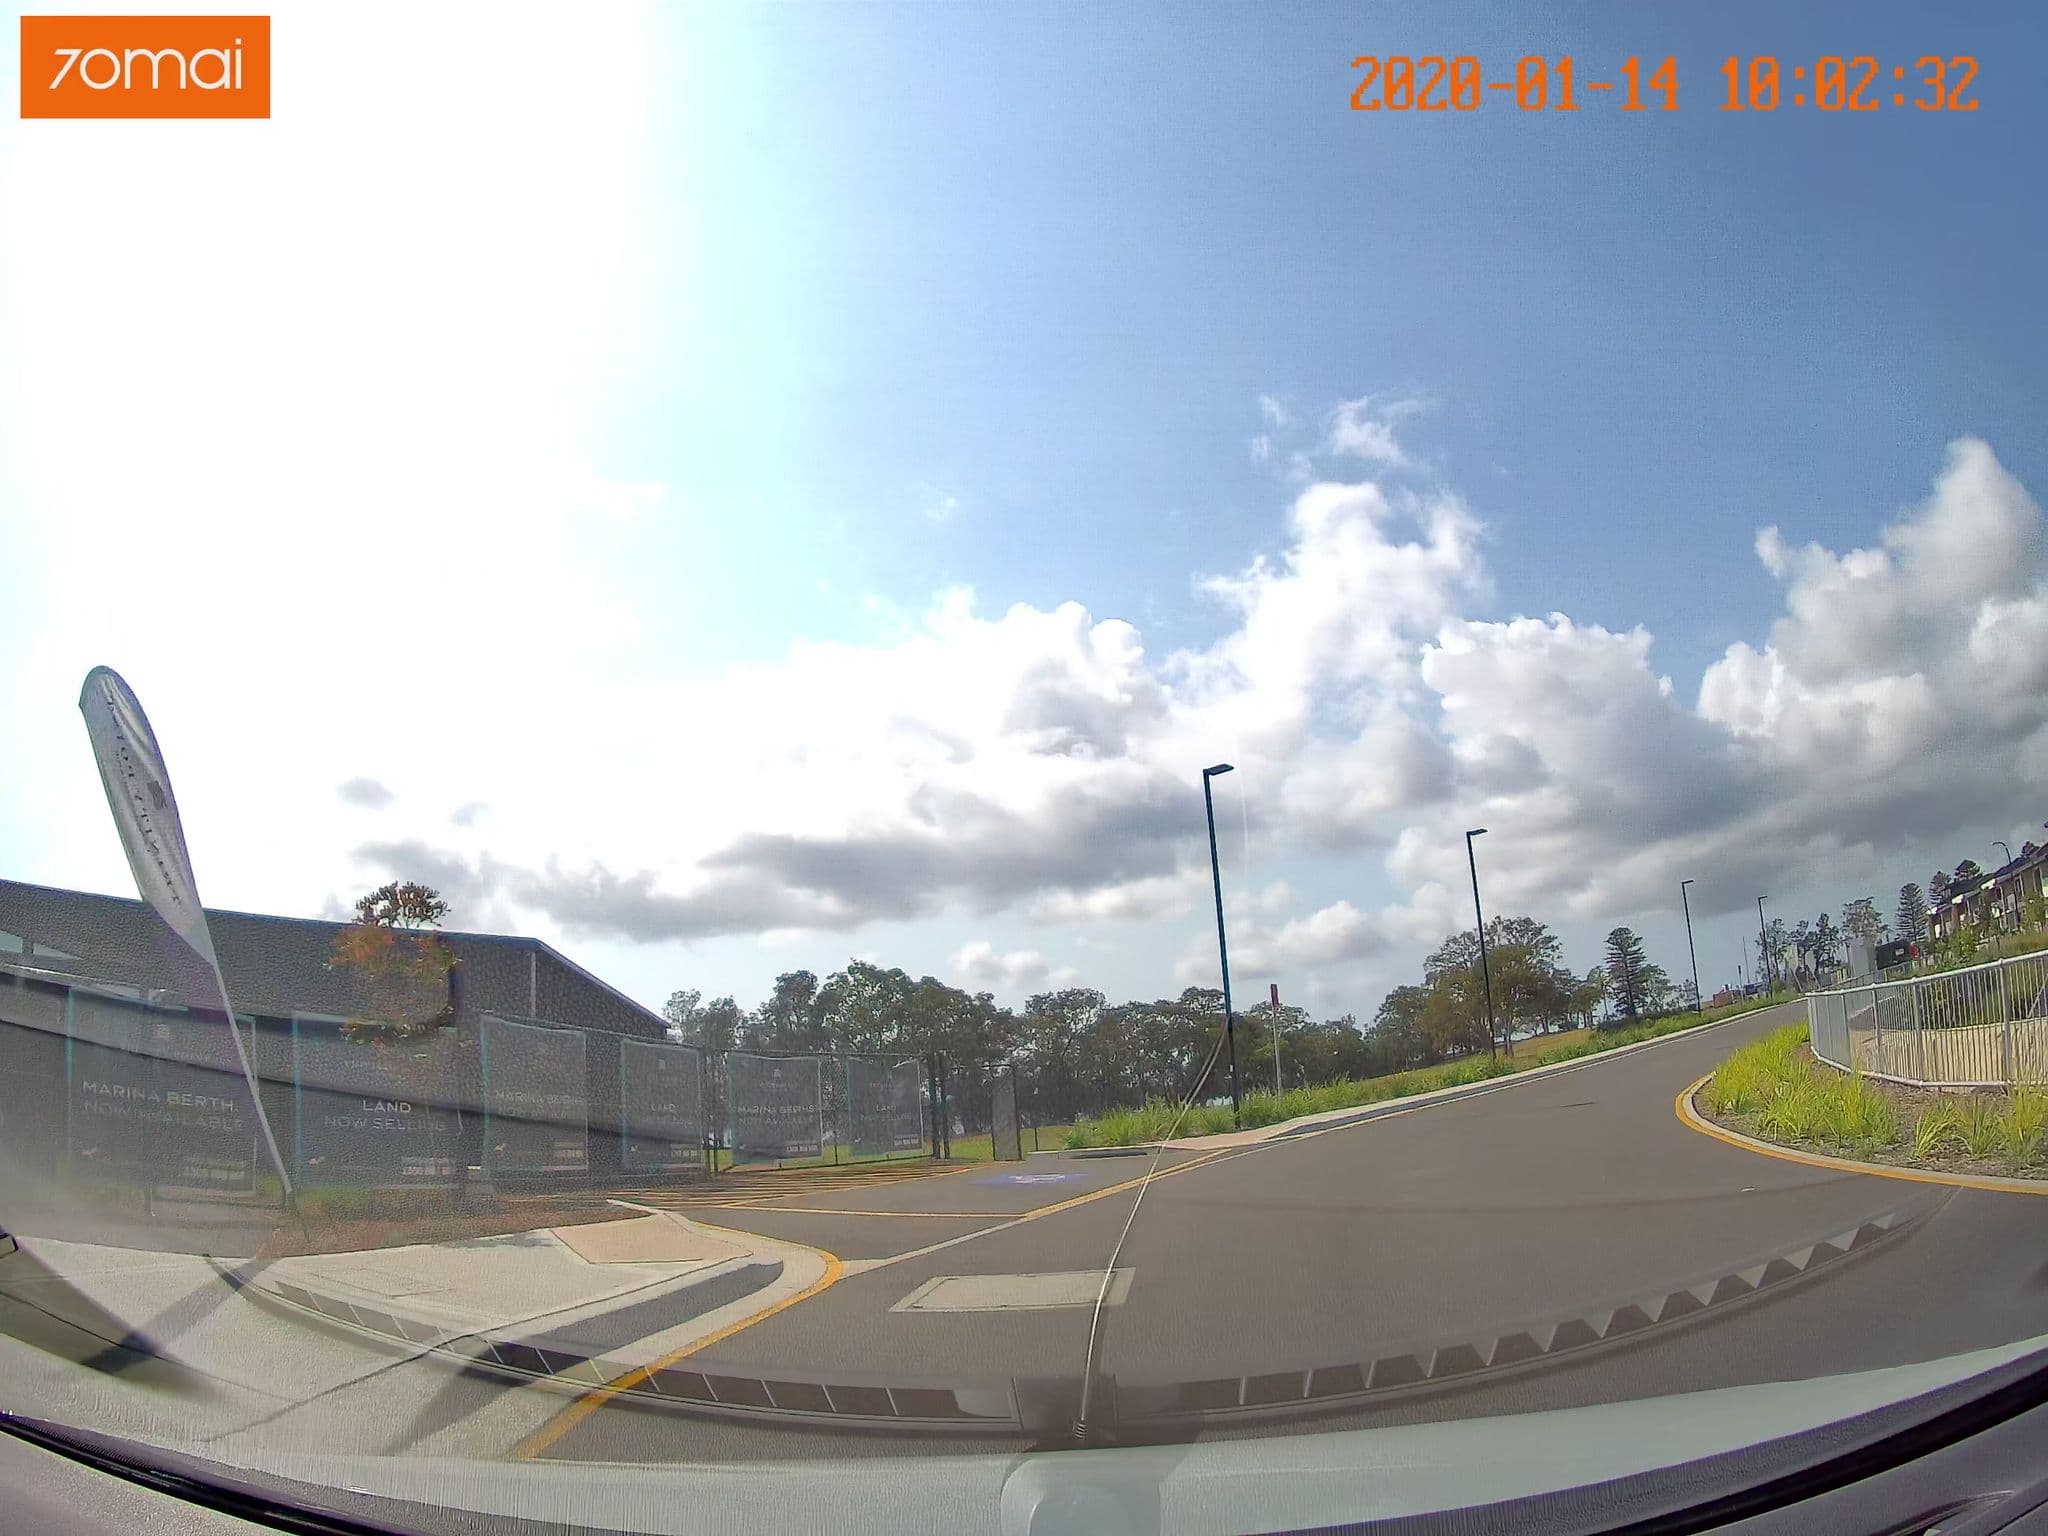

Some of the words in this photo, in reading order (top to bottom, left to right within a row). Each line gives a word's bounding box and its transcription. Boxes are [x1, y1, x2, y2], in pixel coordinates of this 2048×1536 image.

[83, 1080, 160, 1103] MARINA
[362, 1099, 412, 1114] LAND
[133, 1108, 244, 1131] AILABLE
[324, 1115, 368, 1129] NOW
